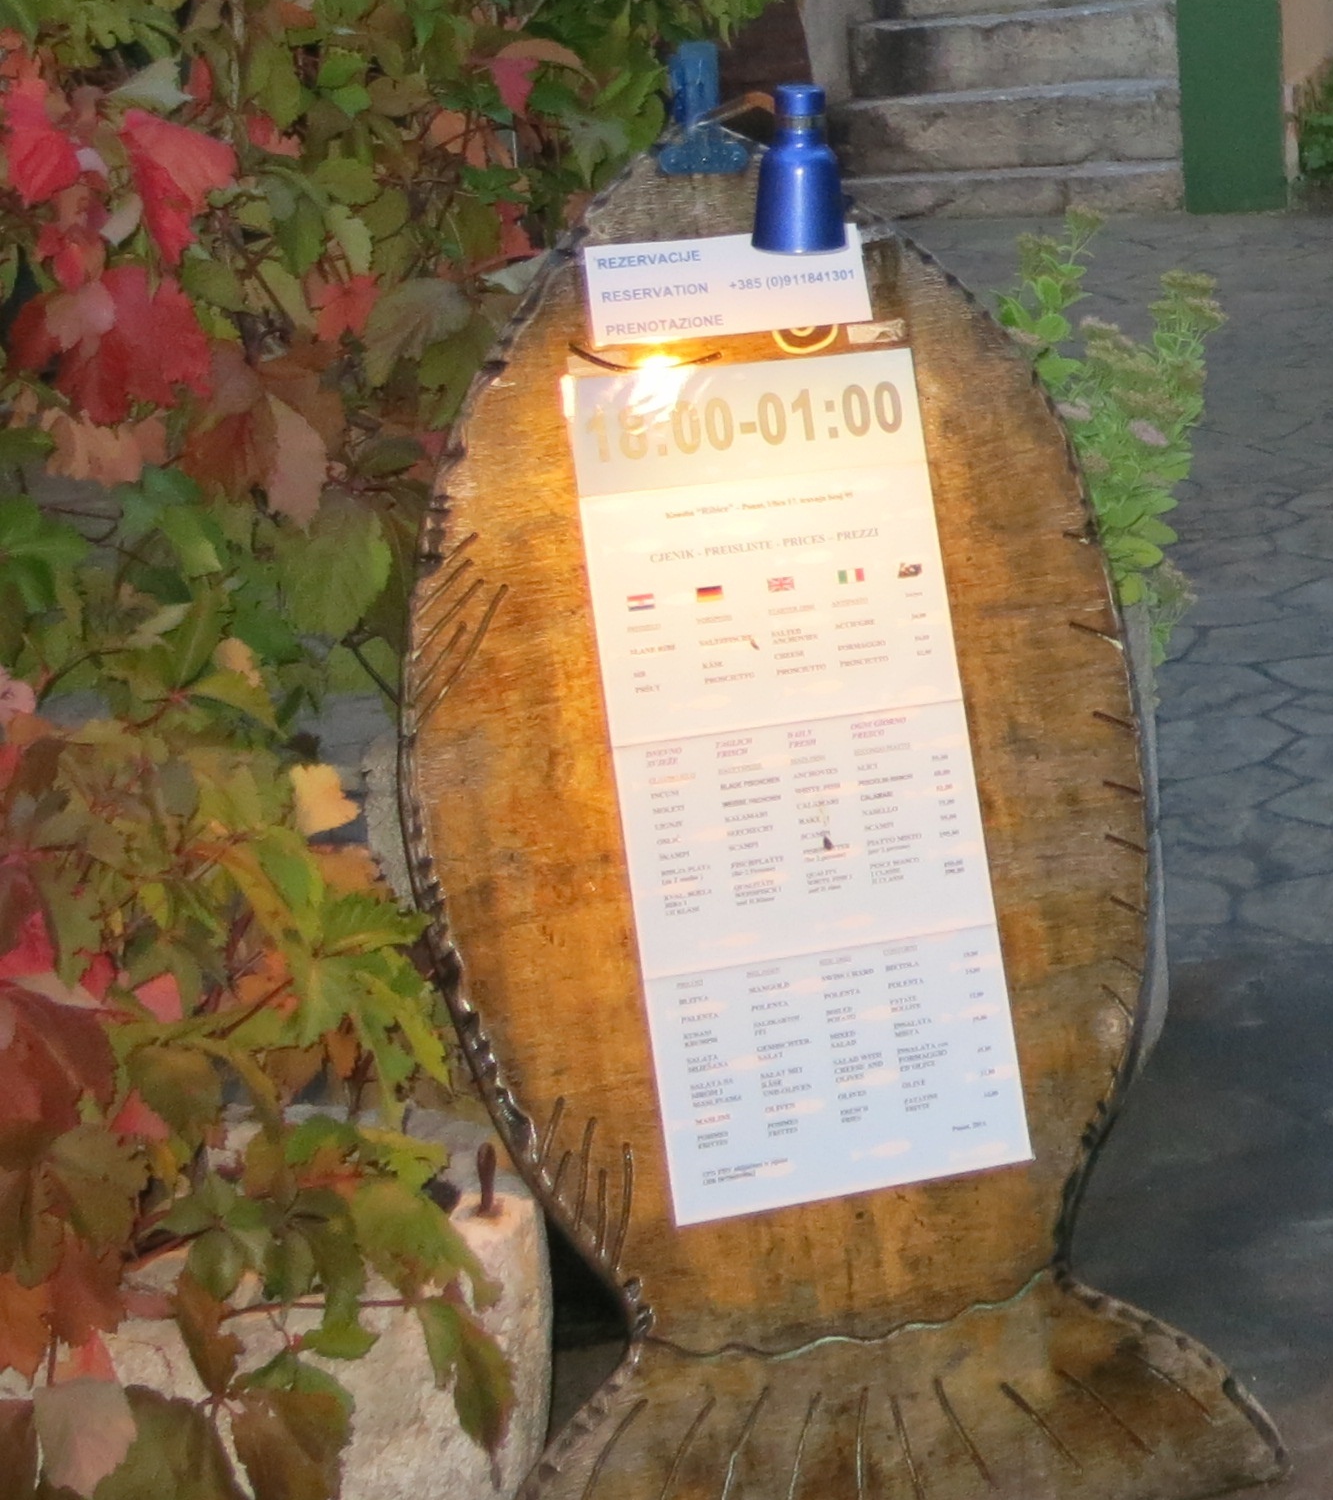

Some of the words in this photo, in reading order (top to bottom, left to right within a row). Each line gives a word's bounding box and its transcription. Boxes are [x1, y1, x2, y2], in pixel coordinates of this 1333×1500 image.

[596, 250, 701, 270] REZERVACIJE
[601, 281, 709, 303] RESERVATION
[728, 277, 762, 292] +385
[765, 269, 855, 291] (0)911841301
[605, 313, 724, 336] PRENOTAZIONE
[650, 550, 694, 563] CJENIK
[704, 540, 773, 557] PREISLISTE
[783, 534, 826, 547] PRICES
[837, 527, 879, 541] PREZZI
